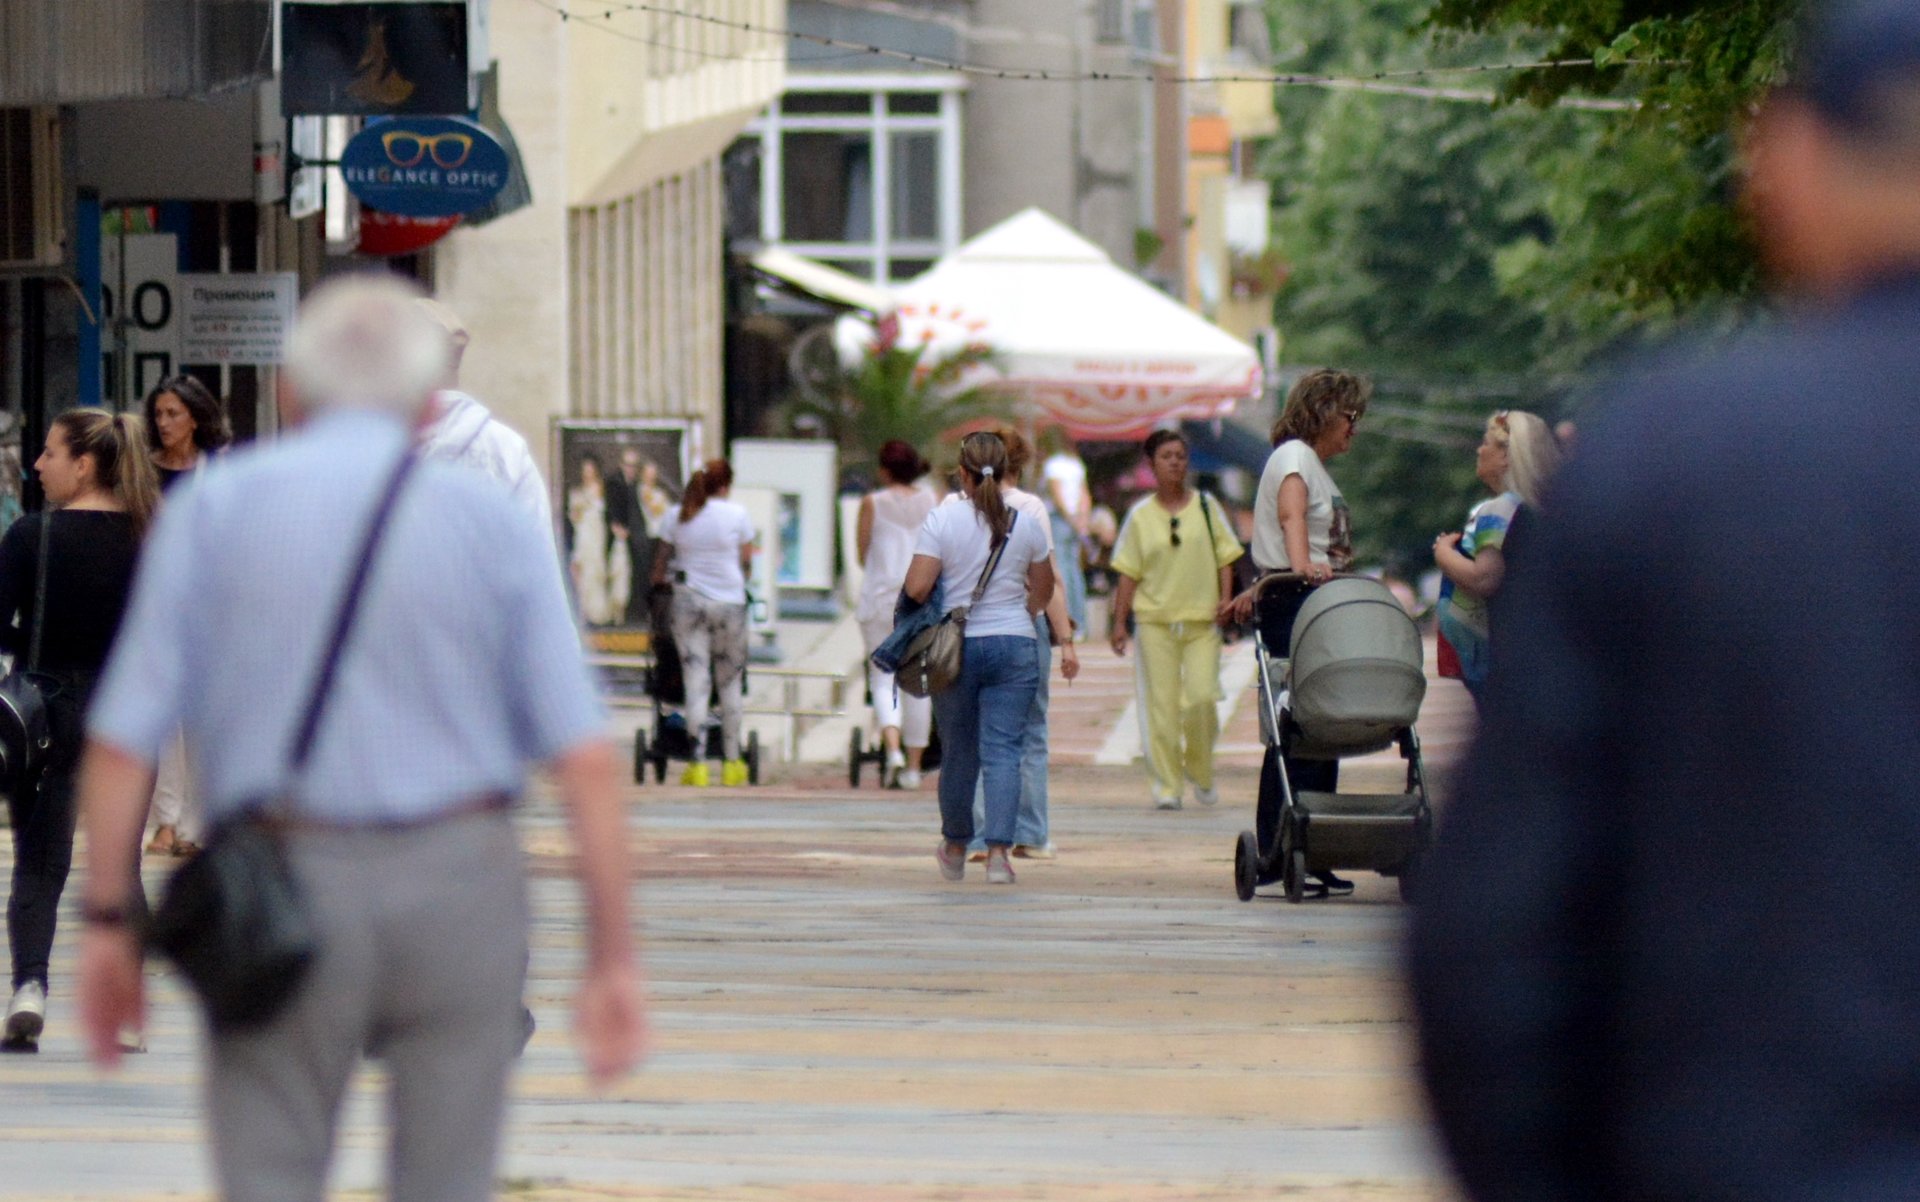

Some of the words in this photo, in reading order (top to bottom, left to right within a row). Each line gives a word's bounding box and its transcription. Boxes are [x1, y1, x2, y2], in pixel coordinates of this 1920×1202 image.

[346, 166, 440, 185] ELEGANCE
[446, 170, 499, 187] OPTIC
[193, 287, 276, 304] Промоция
